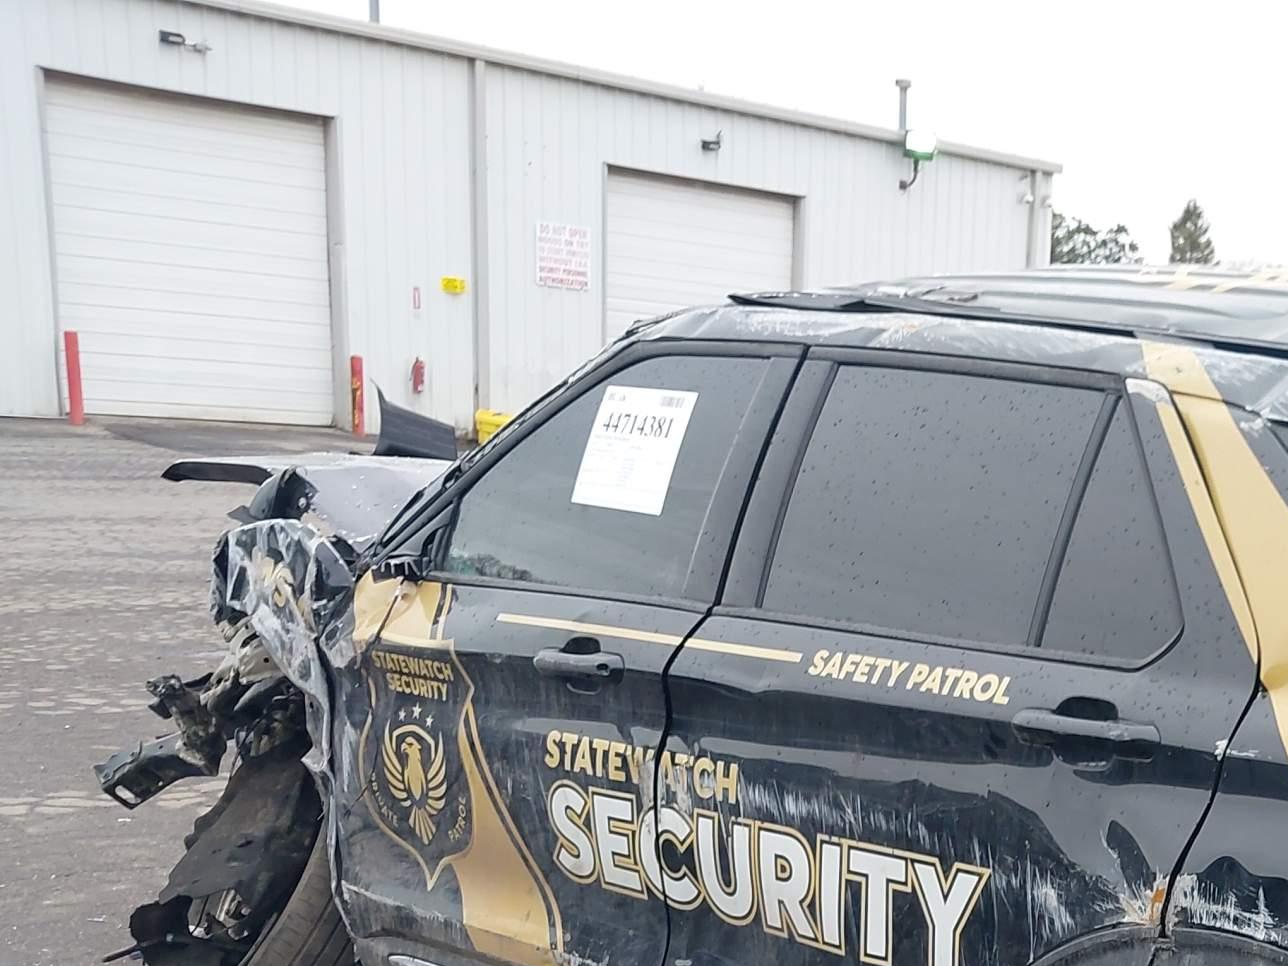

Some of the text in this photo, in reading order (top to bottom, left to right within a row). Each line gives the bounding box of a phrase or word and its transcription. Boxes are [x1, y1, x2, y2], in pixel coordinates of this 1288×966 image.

[603, 412, 674, 439] 44714381
[371, 650, 455, 682] STATEWATCH
[808, 649, 1011, 705] SAFETY PATROL
[385, 672, 448, 702] SECURITY
[544, 729, 740, 805] STATEWATCH
[448, 796, 467, 843] PATROL
